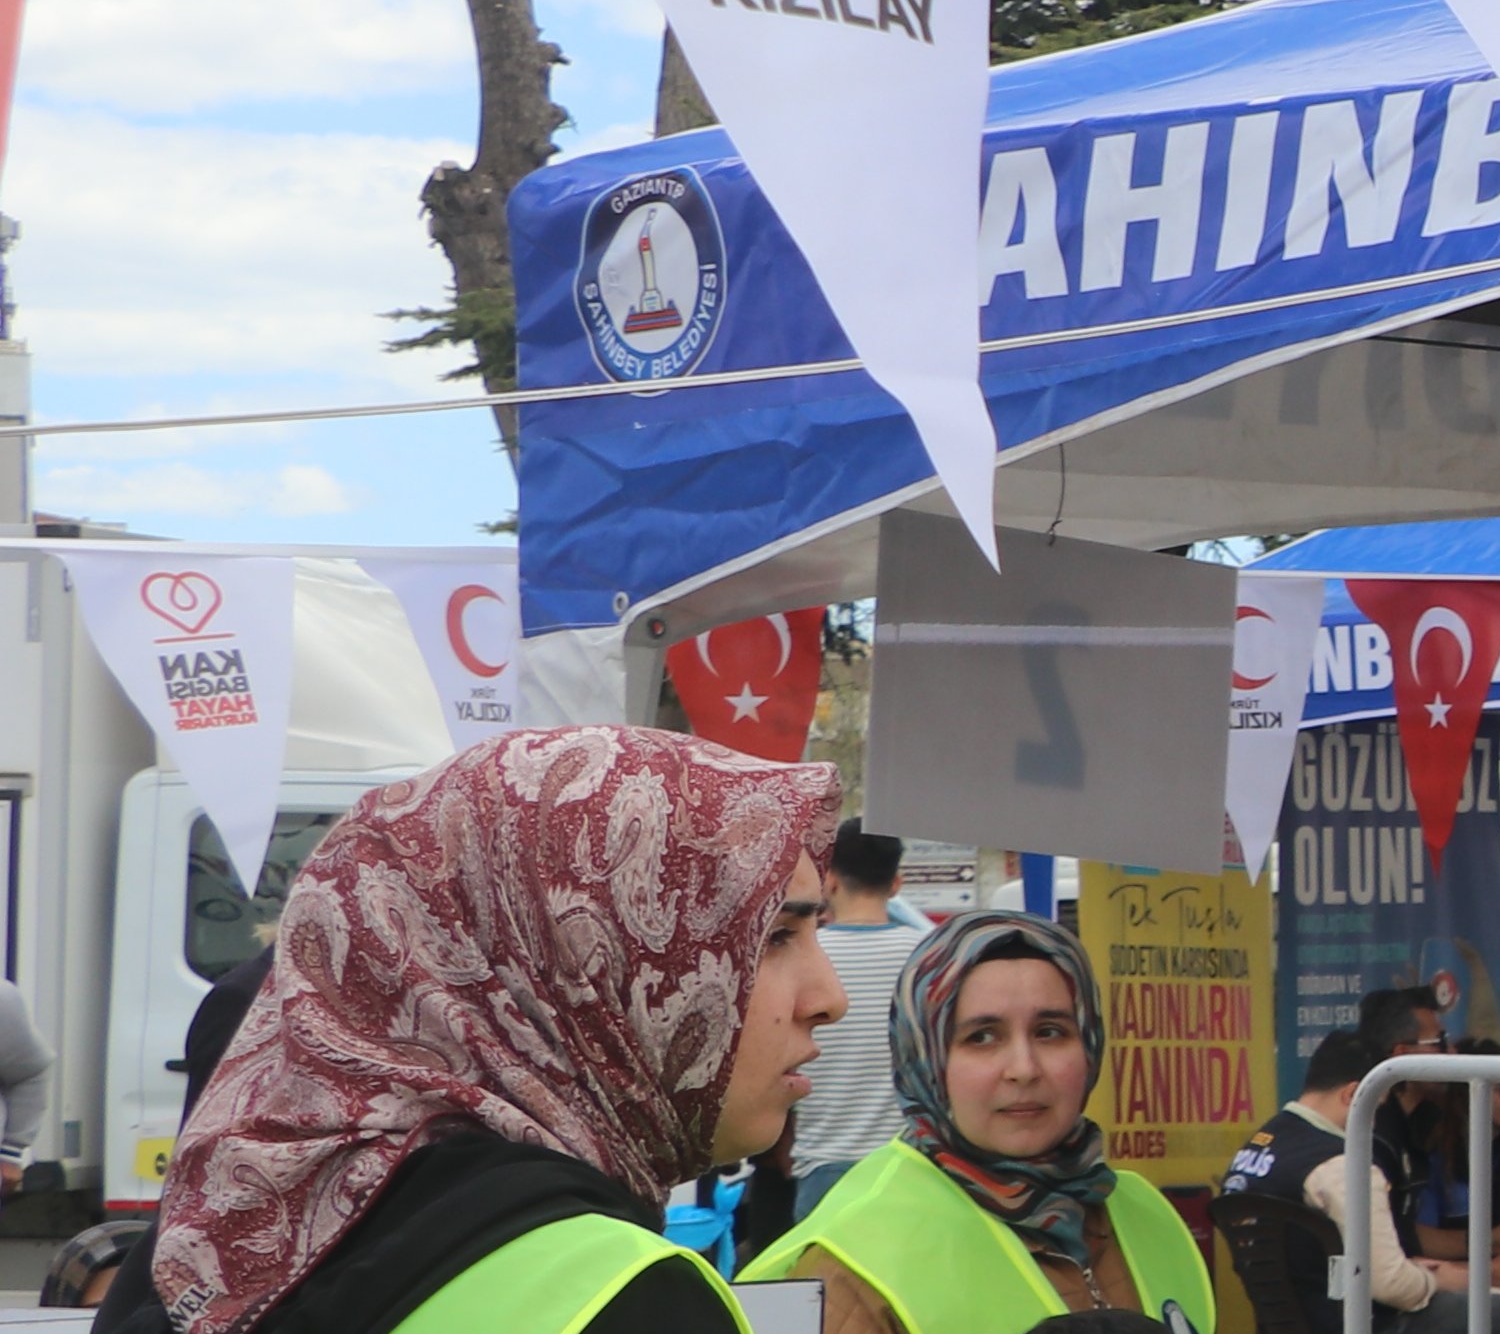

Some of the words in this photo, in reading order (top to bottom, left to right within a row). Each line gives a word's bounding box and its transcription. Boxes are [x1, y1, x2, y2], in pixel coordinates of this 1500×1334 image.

[1293, 825, 1425, 906] OLUN!
[1108, 982, 1253, 1042] KADINLARIN
[1111, 1046, 1255, 1125] YANINDA
[1108, 1130, 1167, 1159] KADES
